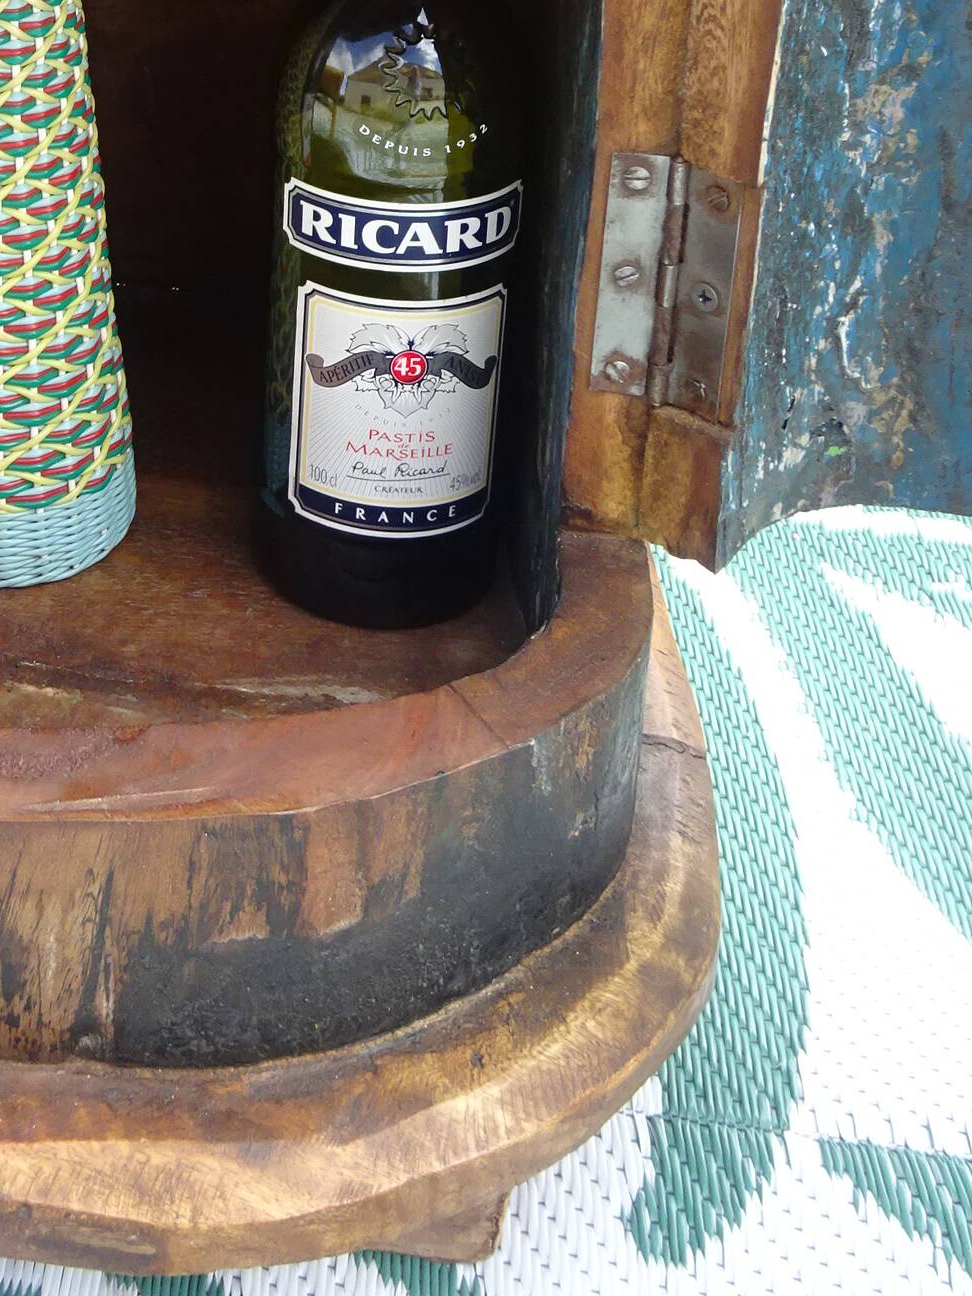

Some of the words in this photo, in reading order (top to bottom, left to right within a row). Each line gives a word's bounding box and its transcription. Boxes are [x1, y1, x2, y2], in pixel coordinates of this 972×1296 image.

[359, 124, 432, 157] DEPUIS
[444, 124, 488, 154] 1932
[300, 200, 512, 255] RICARD
[319, 354, 374, 384] APÉRITIF
[394, 357, 422, 376] 45
[368, 429, 436, 443] PASTIS
[346, 440, 453, 461] MARSEILLE
[351, 461, 388, 478] Paul
[394, 459, 448, 478] Ricard
[335, 502, 457, 524] FRANCE
